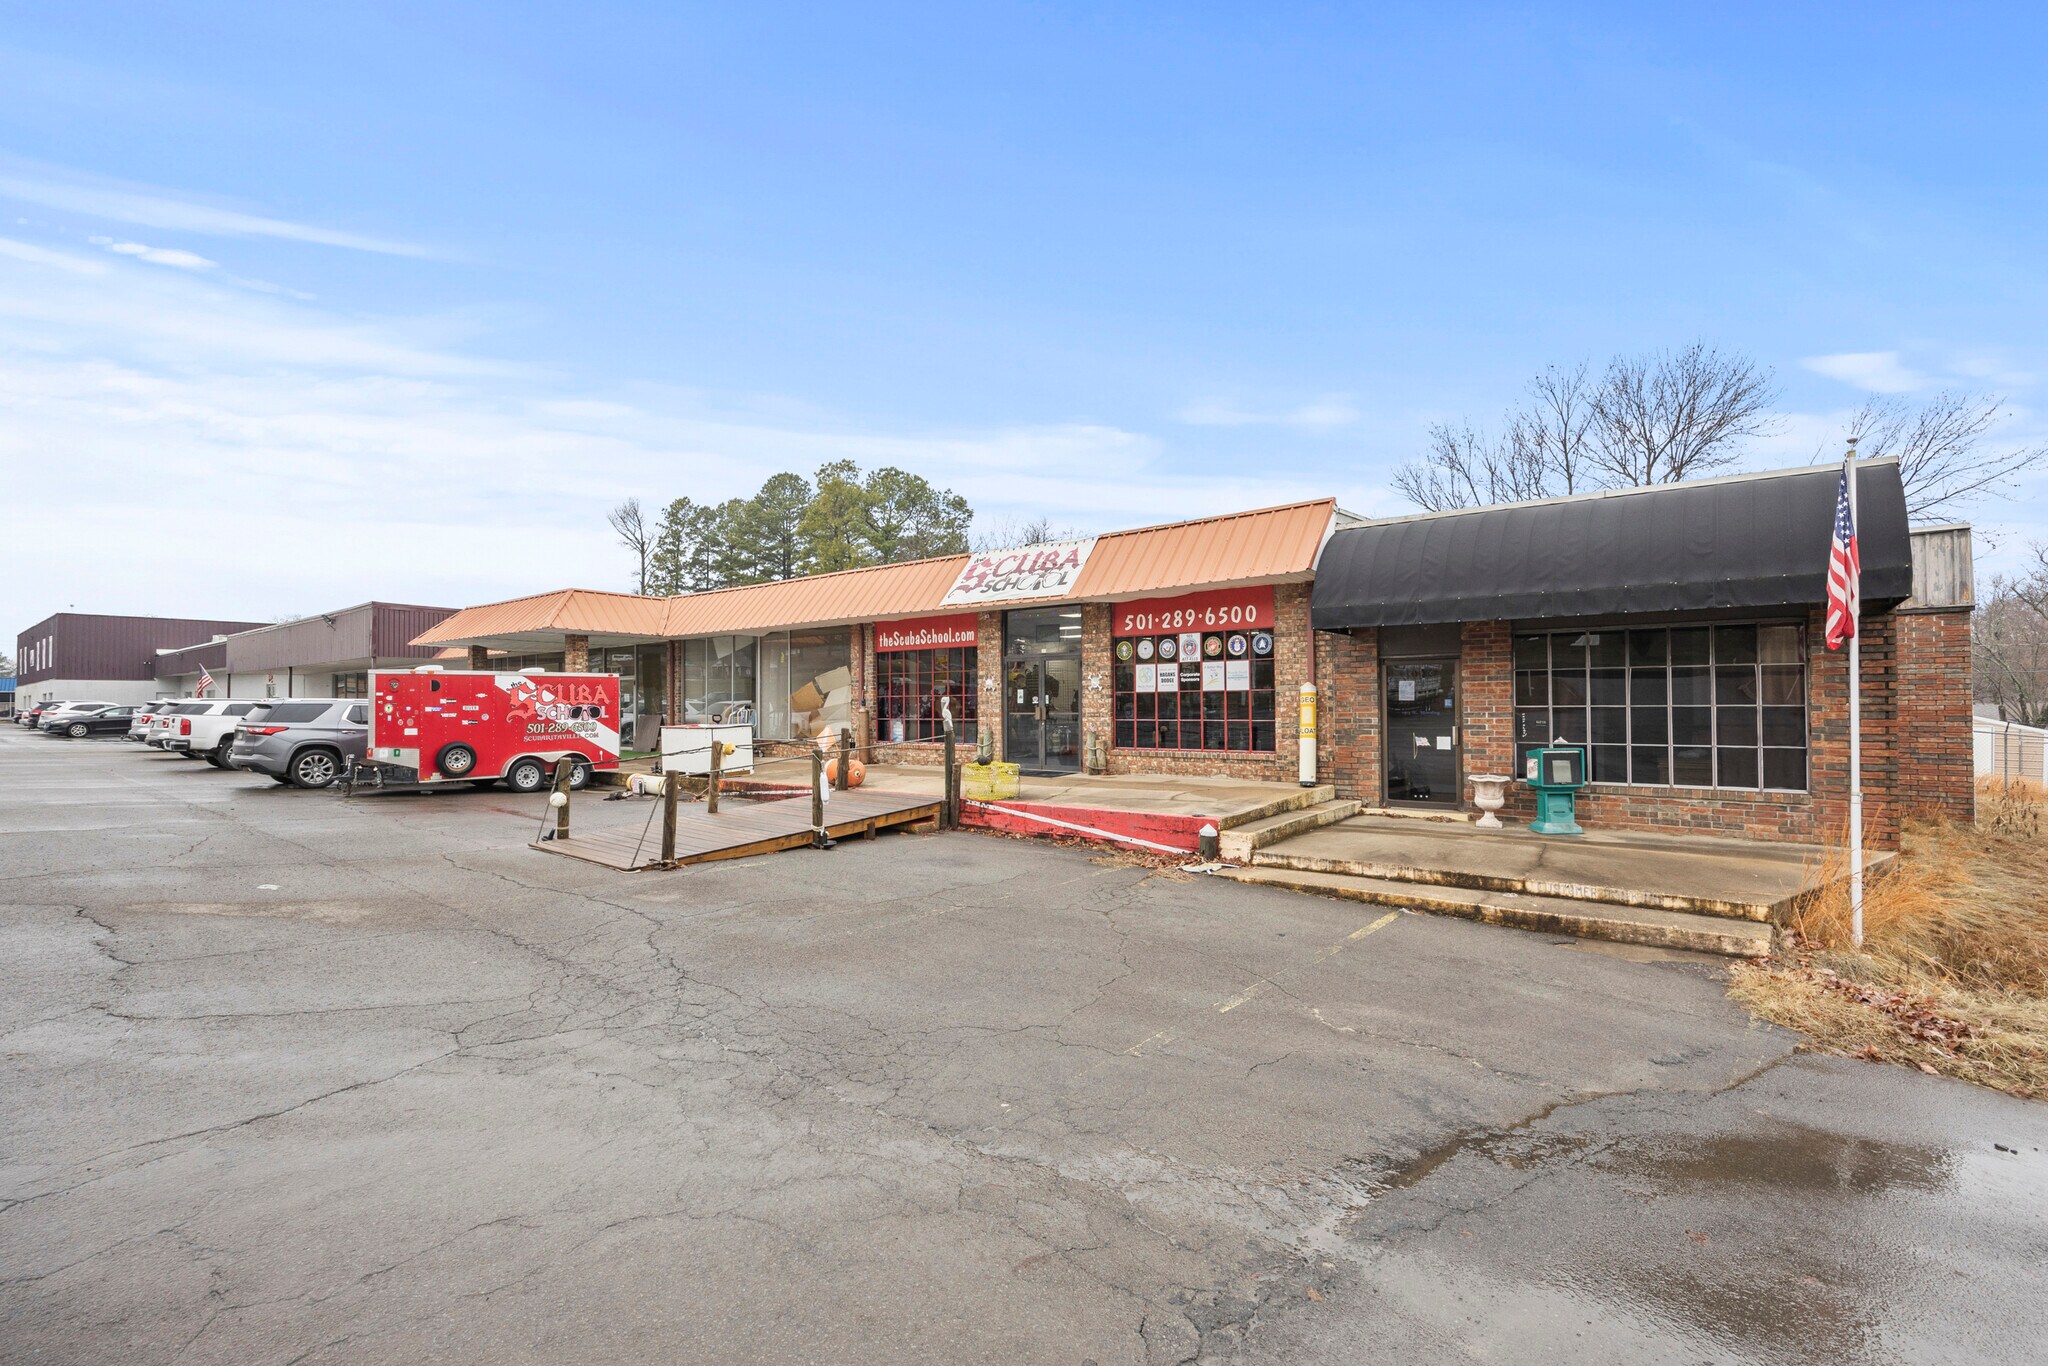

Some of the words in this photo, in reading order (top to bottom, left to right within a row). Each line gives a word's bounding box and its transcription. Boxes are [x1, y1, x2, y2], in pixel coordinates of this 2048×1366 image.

[948, 546, 1082, 598] SCUBA
[879, 627, 975, 648] theScubaSchool.com
[510, 681, 522, 689] the
[506, 682, 610, 723] SCUBA
[526, 721, 598, 734] 501-289-6500
